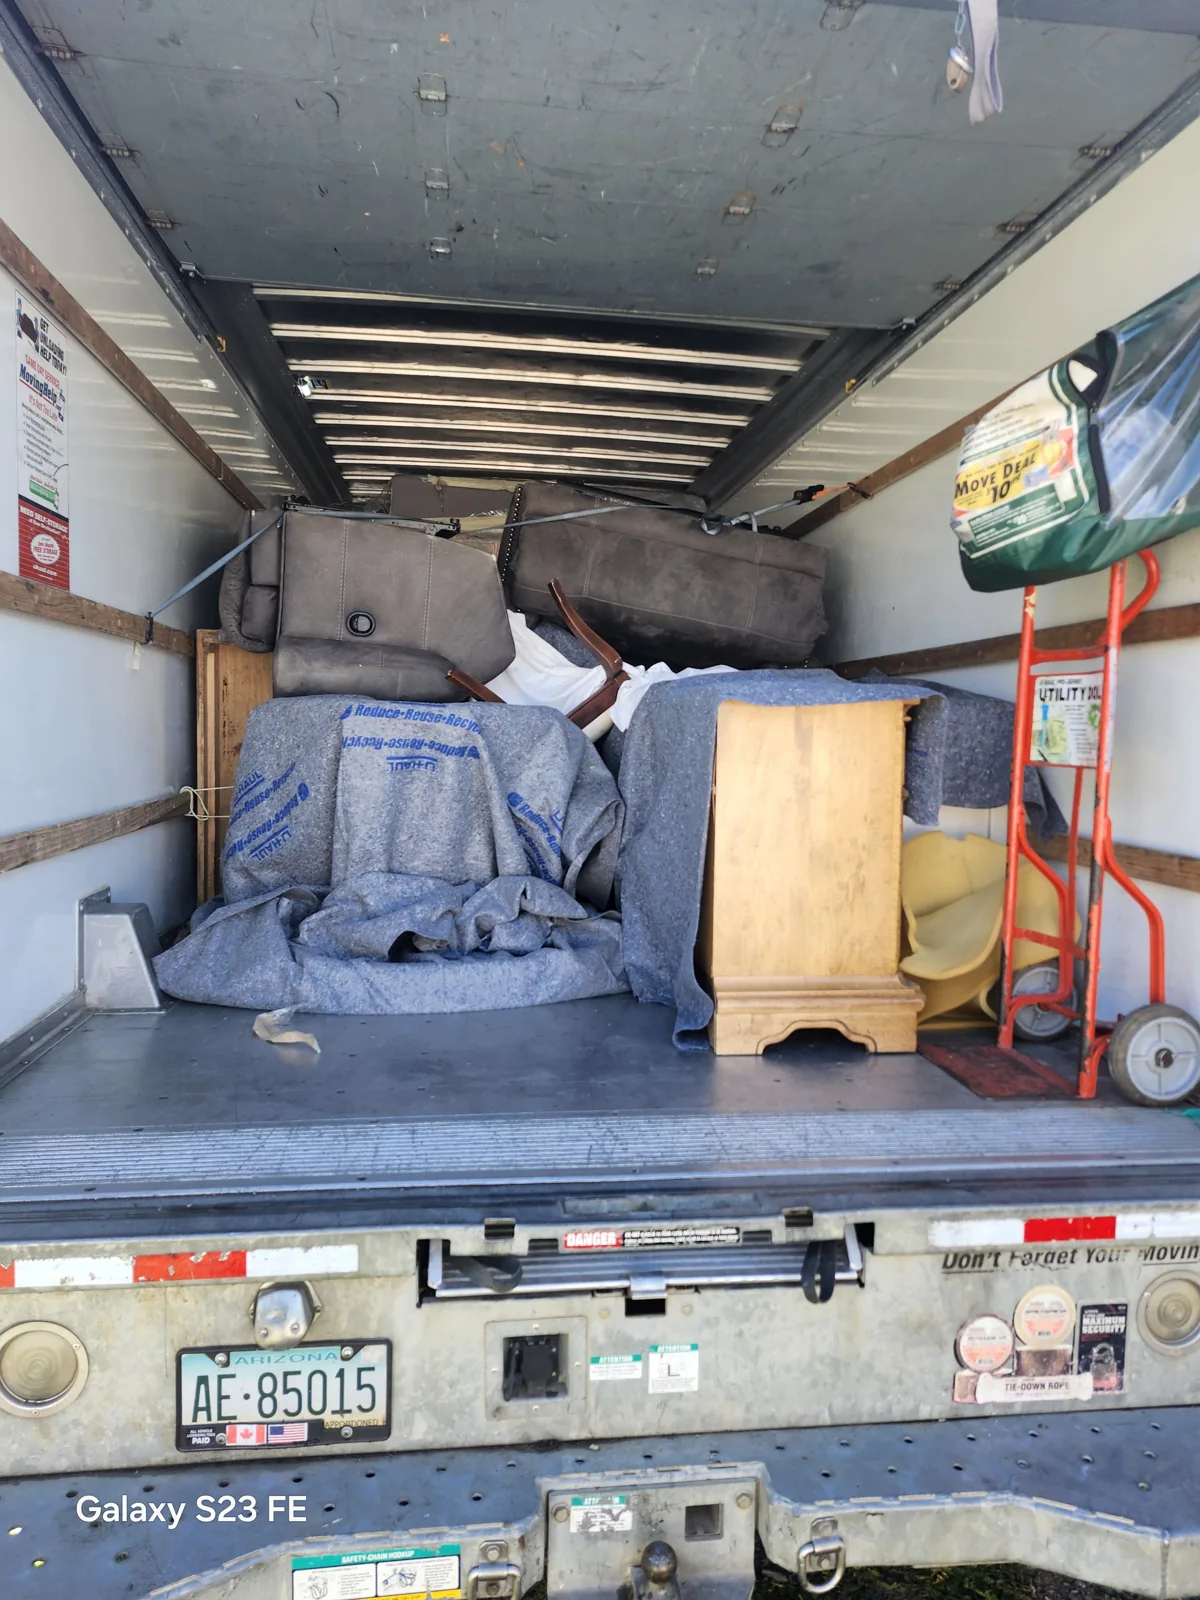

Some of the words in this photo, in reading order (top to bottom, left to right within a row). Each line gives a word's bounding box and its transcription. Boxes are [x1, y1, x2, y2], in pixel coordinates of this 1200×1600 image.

[40, 318, 49, 334] GET
[40, 332, 64, 361] UNLOADING
[40, 345, 51, 363] HELP
[52, 356, 68, 376] TODAY!
[25, 353, 36, 370] SAME
[45, 369, 60, 388] SERVICE
[955, 471, 996, 498] MOVE
[1040, 686, 1086, 701] UTILITY
[566, 1231, 617, 1247] DANGER
[942, 1251, 1001, 1269] Don't
[1083, 1316, 1126, 1325] MAXIMUM
[1082, 1325, 1126, 1334] SECURITY
[235, 1352, 338, 1365] ARIZONA
[1005, 1383, 1046, 1391] TIE-DOWN
[1048, 1381, 1070, 1390] ROPE
[341, 1553, 389, 1565] SAFETY-CHAIN
[389, 1550, 415, 1560] HOOKUP
